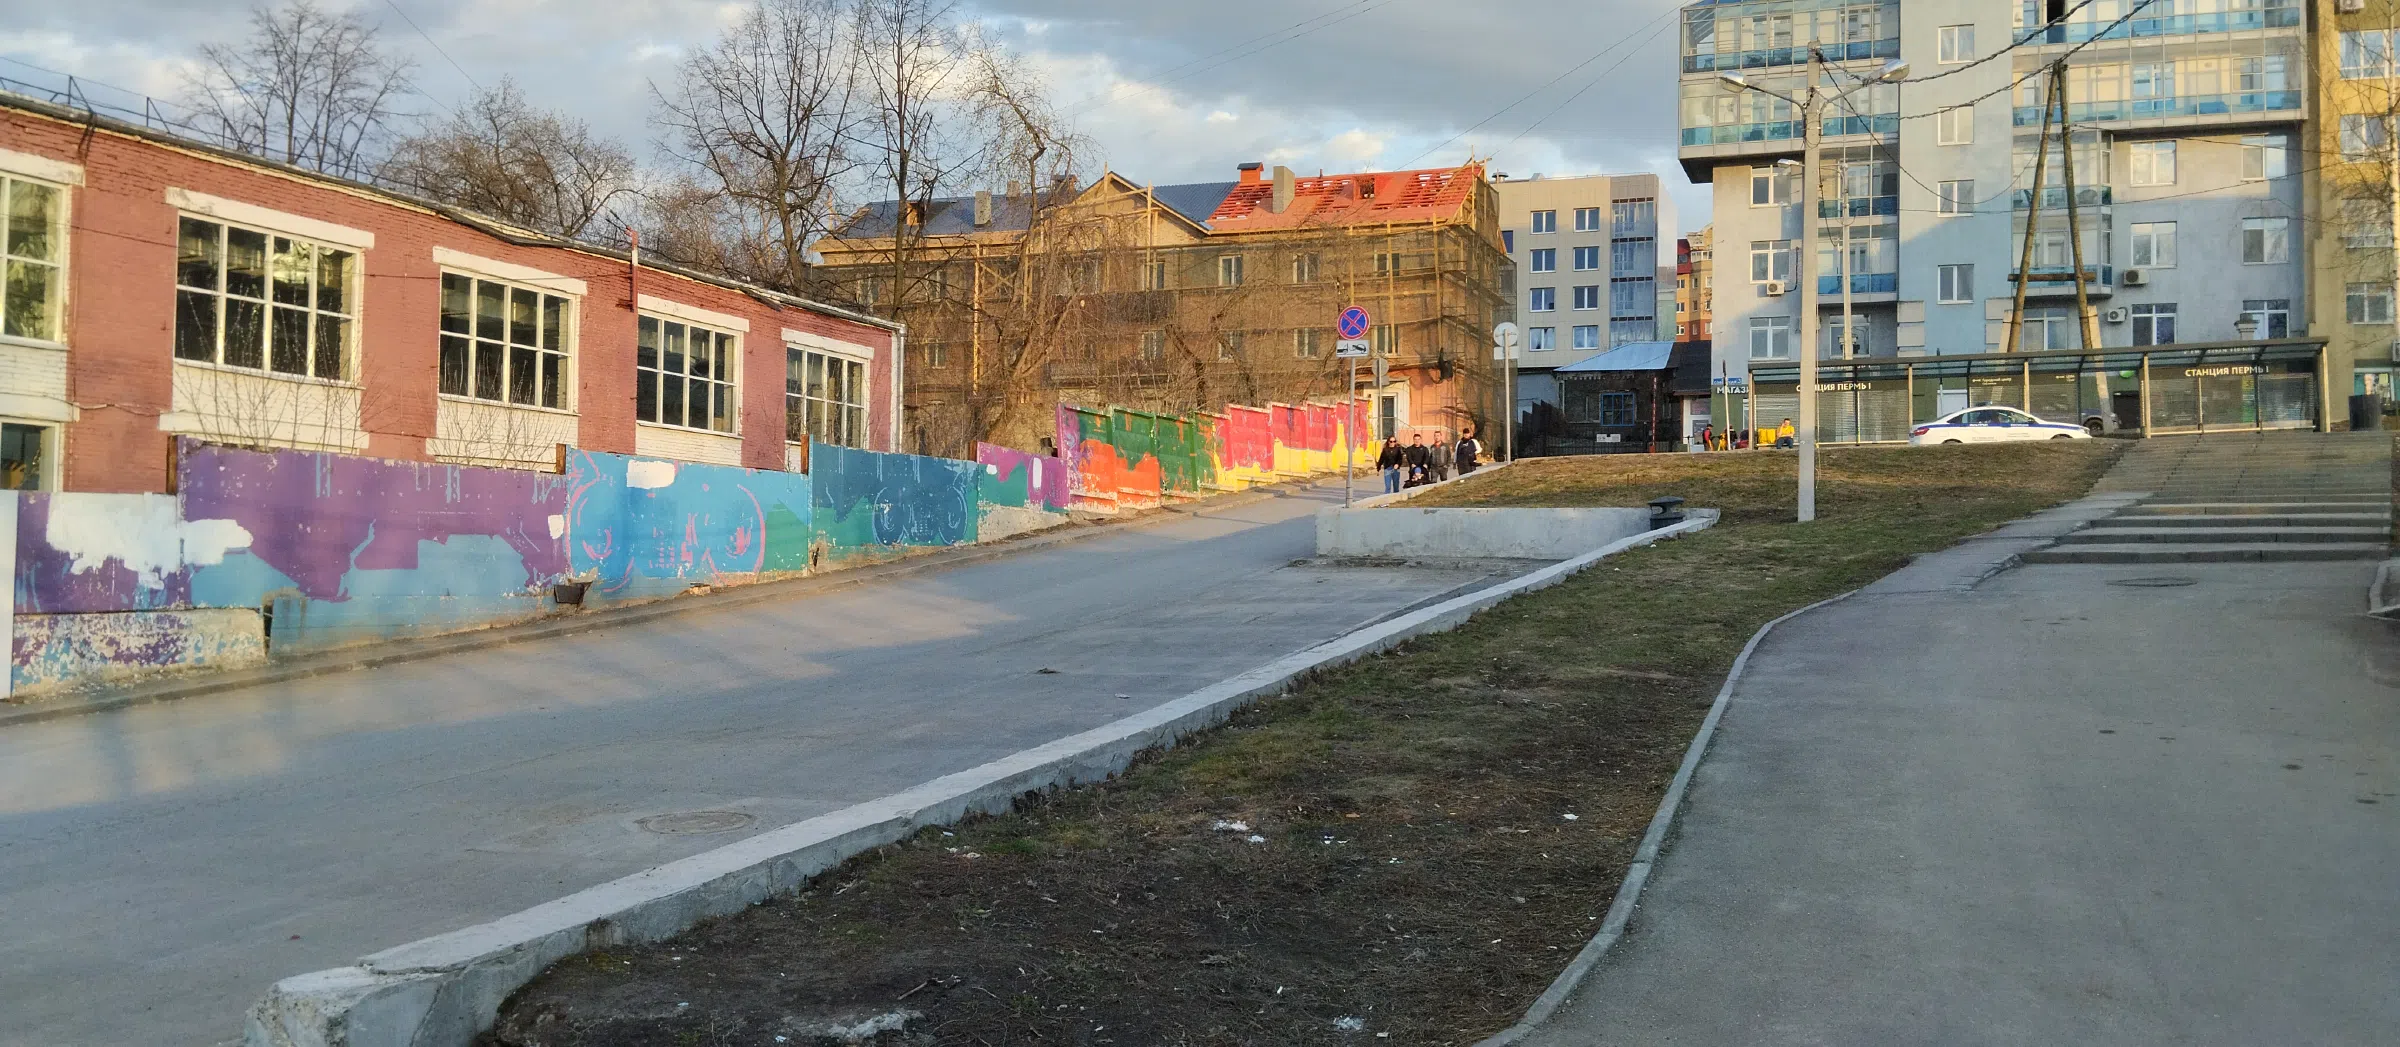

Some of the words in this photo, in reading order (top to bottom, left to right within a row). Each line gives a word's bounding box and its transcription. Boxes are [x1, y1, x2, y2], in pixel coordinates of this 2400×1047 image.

[2185, 368, 2229, 377] СТАНЦИЯ
[2231, 365, 2264, 375] ПЕРМЬ
[1796, 384, 1835, 392] СЦИЯ
[1837, 383, 1867, 391] ПЕРМЬ
